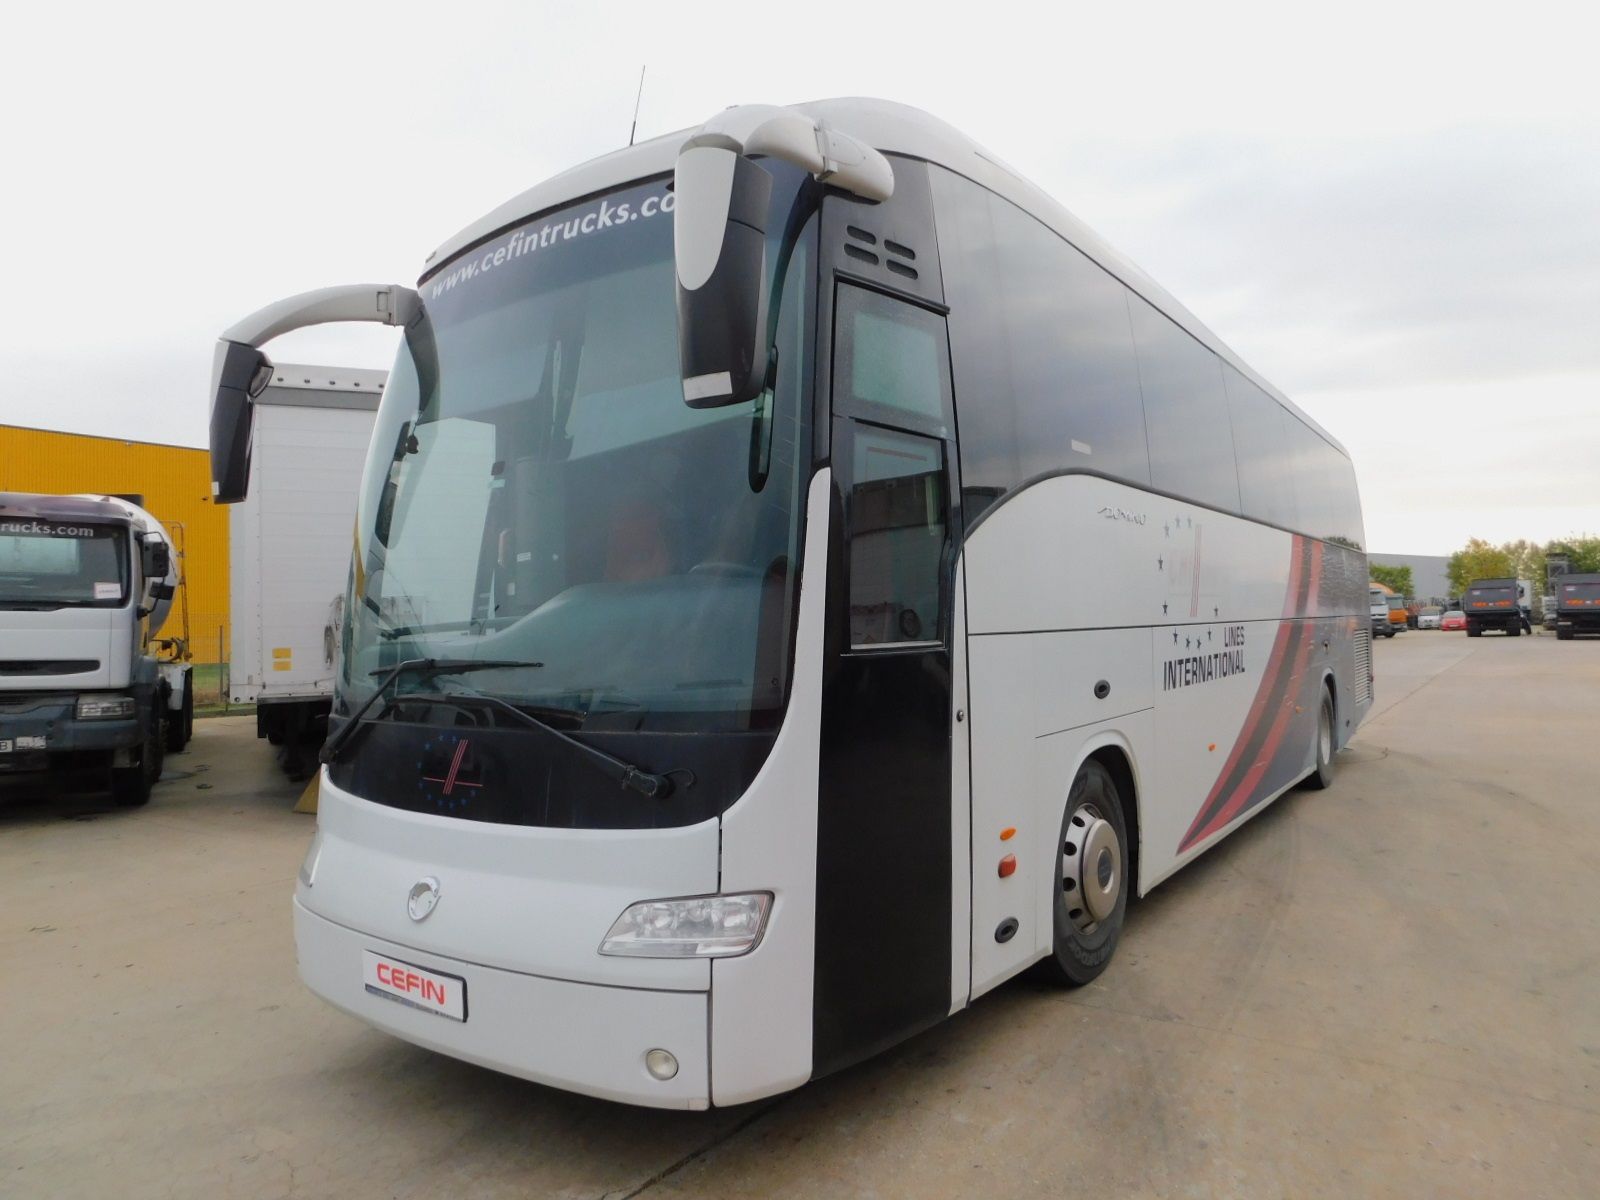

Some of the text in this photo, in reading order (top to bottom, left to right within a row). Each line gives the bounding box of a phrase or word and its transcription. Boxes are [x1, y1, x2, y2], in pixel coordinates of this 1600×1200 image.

[0, 521, 94, 537] rucks.com
[1224, 626, 1246, 647] LINES
[1163, 649, 1246, 691] INTERNATIONAL
[377, 963, 445, 1005] CEFIN
